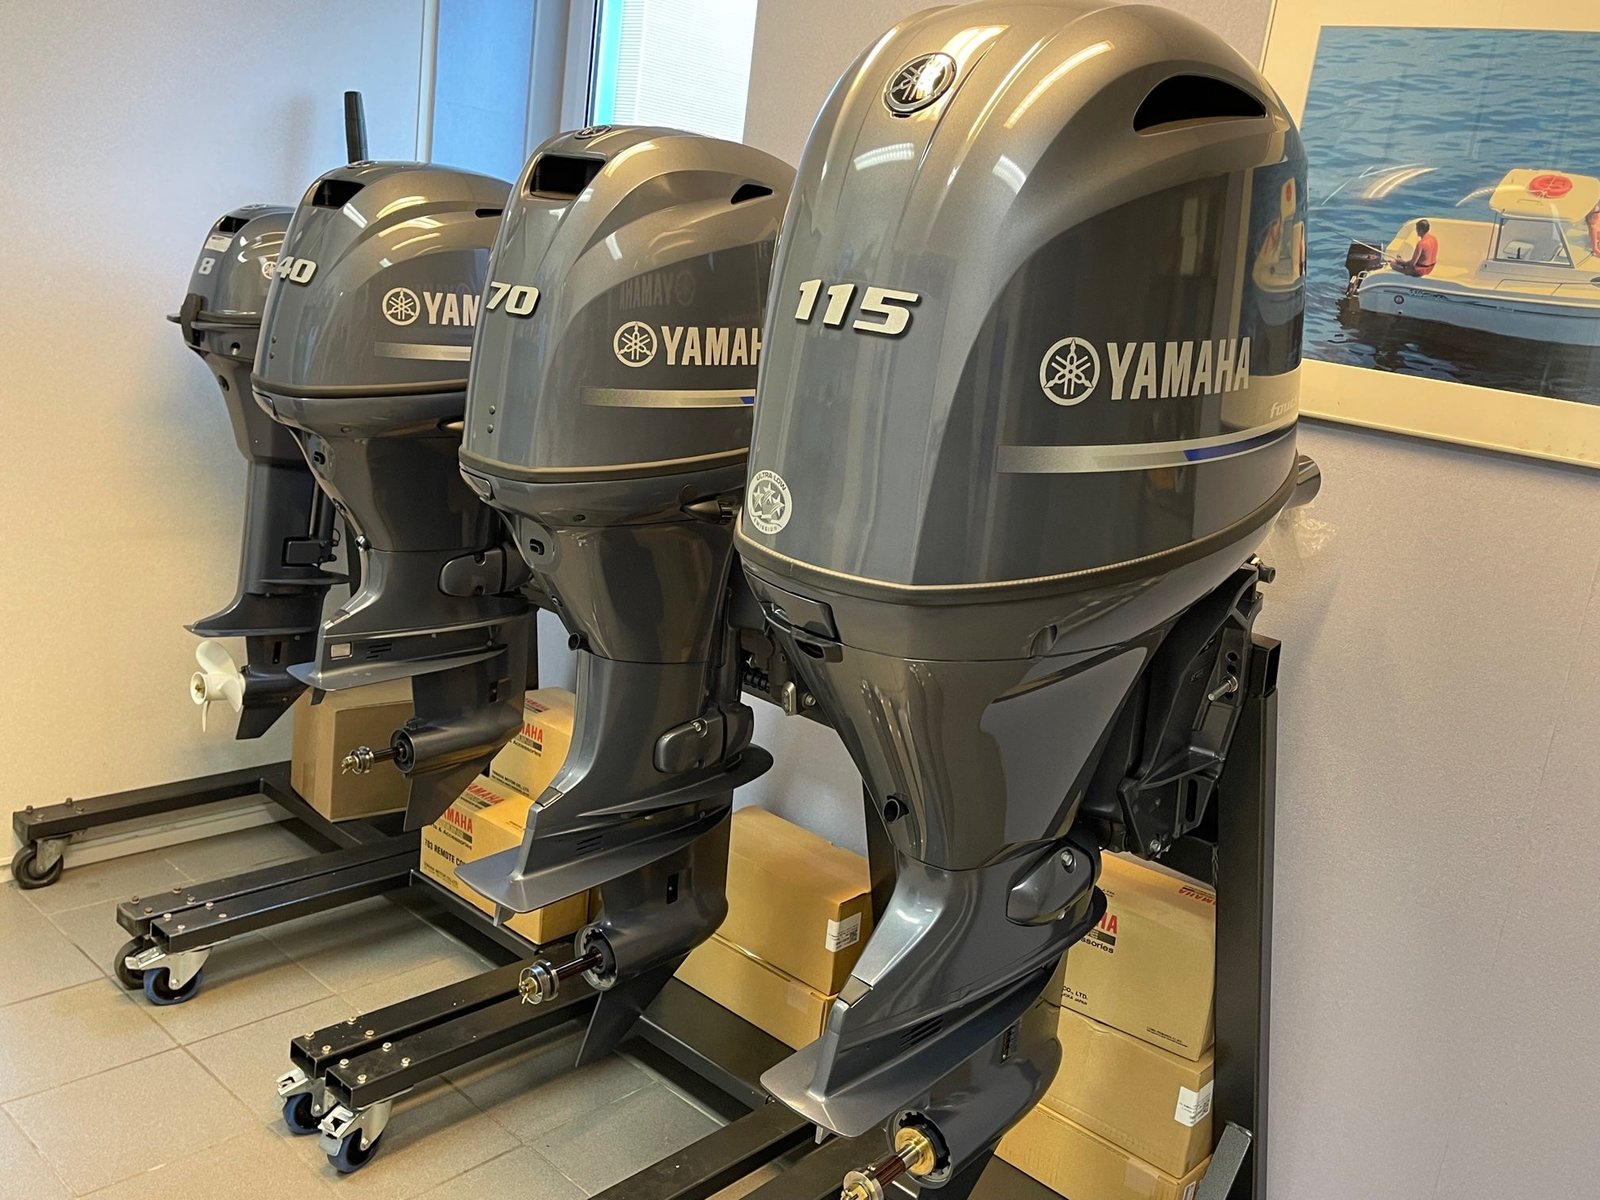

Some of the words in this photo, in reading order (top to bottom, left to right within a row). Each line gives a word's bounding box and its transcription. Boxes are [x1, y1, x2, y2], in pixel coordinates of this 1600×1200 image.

[199, 257, 216, 276] 8
[276, 255, 317, 284] 40
[485, 281, 540, 316] 70
[794, 279, 920, 336] 115
[1106, 336, 1251, 400] YAMAHA
[434, 844, 455, 864] REMOTE
